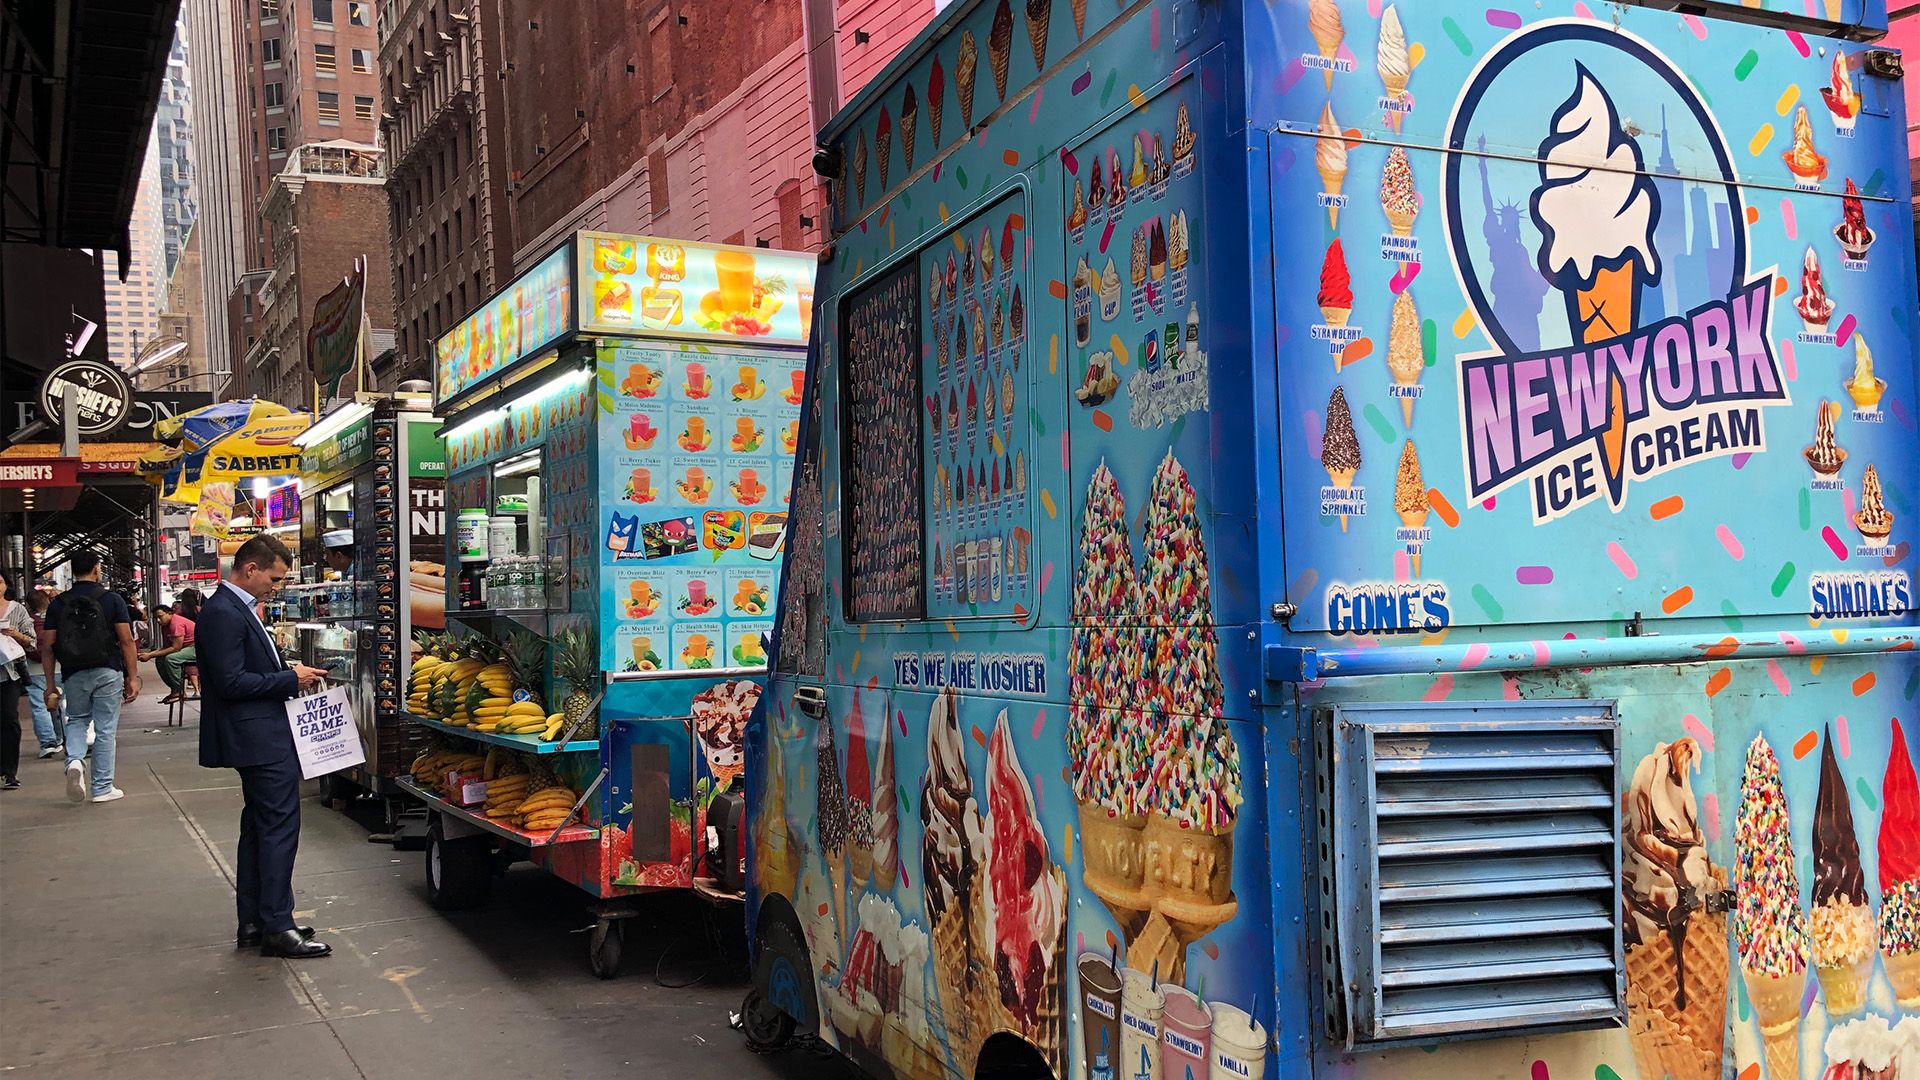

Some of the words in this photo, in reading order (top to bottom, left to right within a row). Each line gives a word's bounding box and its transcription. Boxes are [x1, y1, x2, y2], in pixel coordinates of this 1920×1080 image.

[1302, 54, 1351, 72] CHOCOLATE
[1379, 99, 1412, 113] VANILLA
[1836, 127, 1855, 138] MIXED
[1318, 194, 1348, 207] TWIST
[1381, 236, 1418, 249] RAINBOW
[1381, 250, 1421, 263] SPRINKLE
[1844, 261, 1868, 271] CHERRY
[659, 271, 680, 281] KING
[1075, 286, 1090, 302] SODA
[1104, 301, 1117, 316] CUP
[1311, 327, 1362, 340] STRAWBERRY
[1798, 333, 1837, 344] STRAWBERRY
[1330, 343, 1345, 354] DIP
[1176, 371, 1196, 384] WATER
[1151, 380, 1165, 392] SODA
[1389, 385, 1424, 398] PEANUT
[1852, 411, 1883, 422] PINEAPPLE
[238, 424, 303, 439] SABRETT
[1534, 451, 1597, 518] ICE
[1629, 408, 1761, 476] CREAM
[1811, 480, 1844, 490] CHOCOLATE
[1321, 487, 1364, 501] CHOCOLATE
[1321, 503, 1366, 515] SPRINKLE
[1396, 529, 1431, 541] CHOCOLATE
[1406, 544, 1423, 555] NUT
[1856, 546, 1884, 556] CHOCOLATE
[1884, 548, 1896, 556] NUT
[1810, 573, 1910, 620] SUNDAES
[1328, 583, 1450, 637] CONES
[893, 653, 920, 685] YES
[923, 653, 946, 687] WE
[949, 653, 977, 689] ARE
[980, 654, 1046, 694] KOSHER
[303, 695, 328, 712] WE
[296, 702, 343, 726] KNOW
[300, 714, 347, 738] GAME.
[1087, 996, 1114, 1018] CHOCOLATE
[1165, 1031, 1202, 1057] STRAWBERRY
[1218, 1054, 1248, 1077] VANILLA
